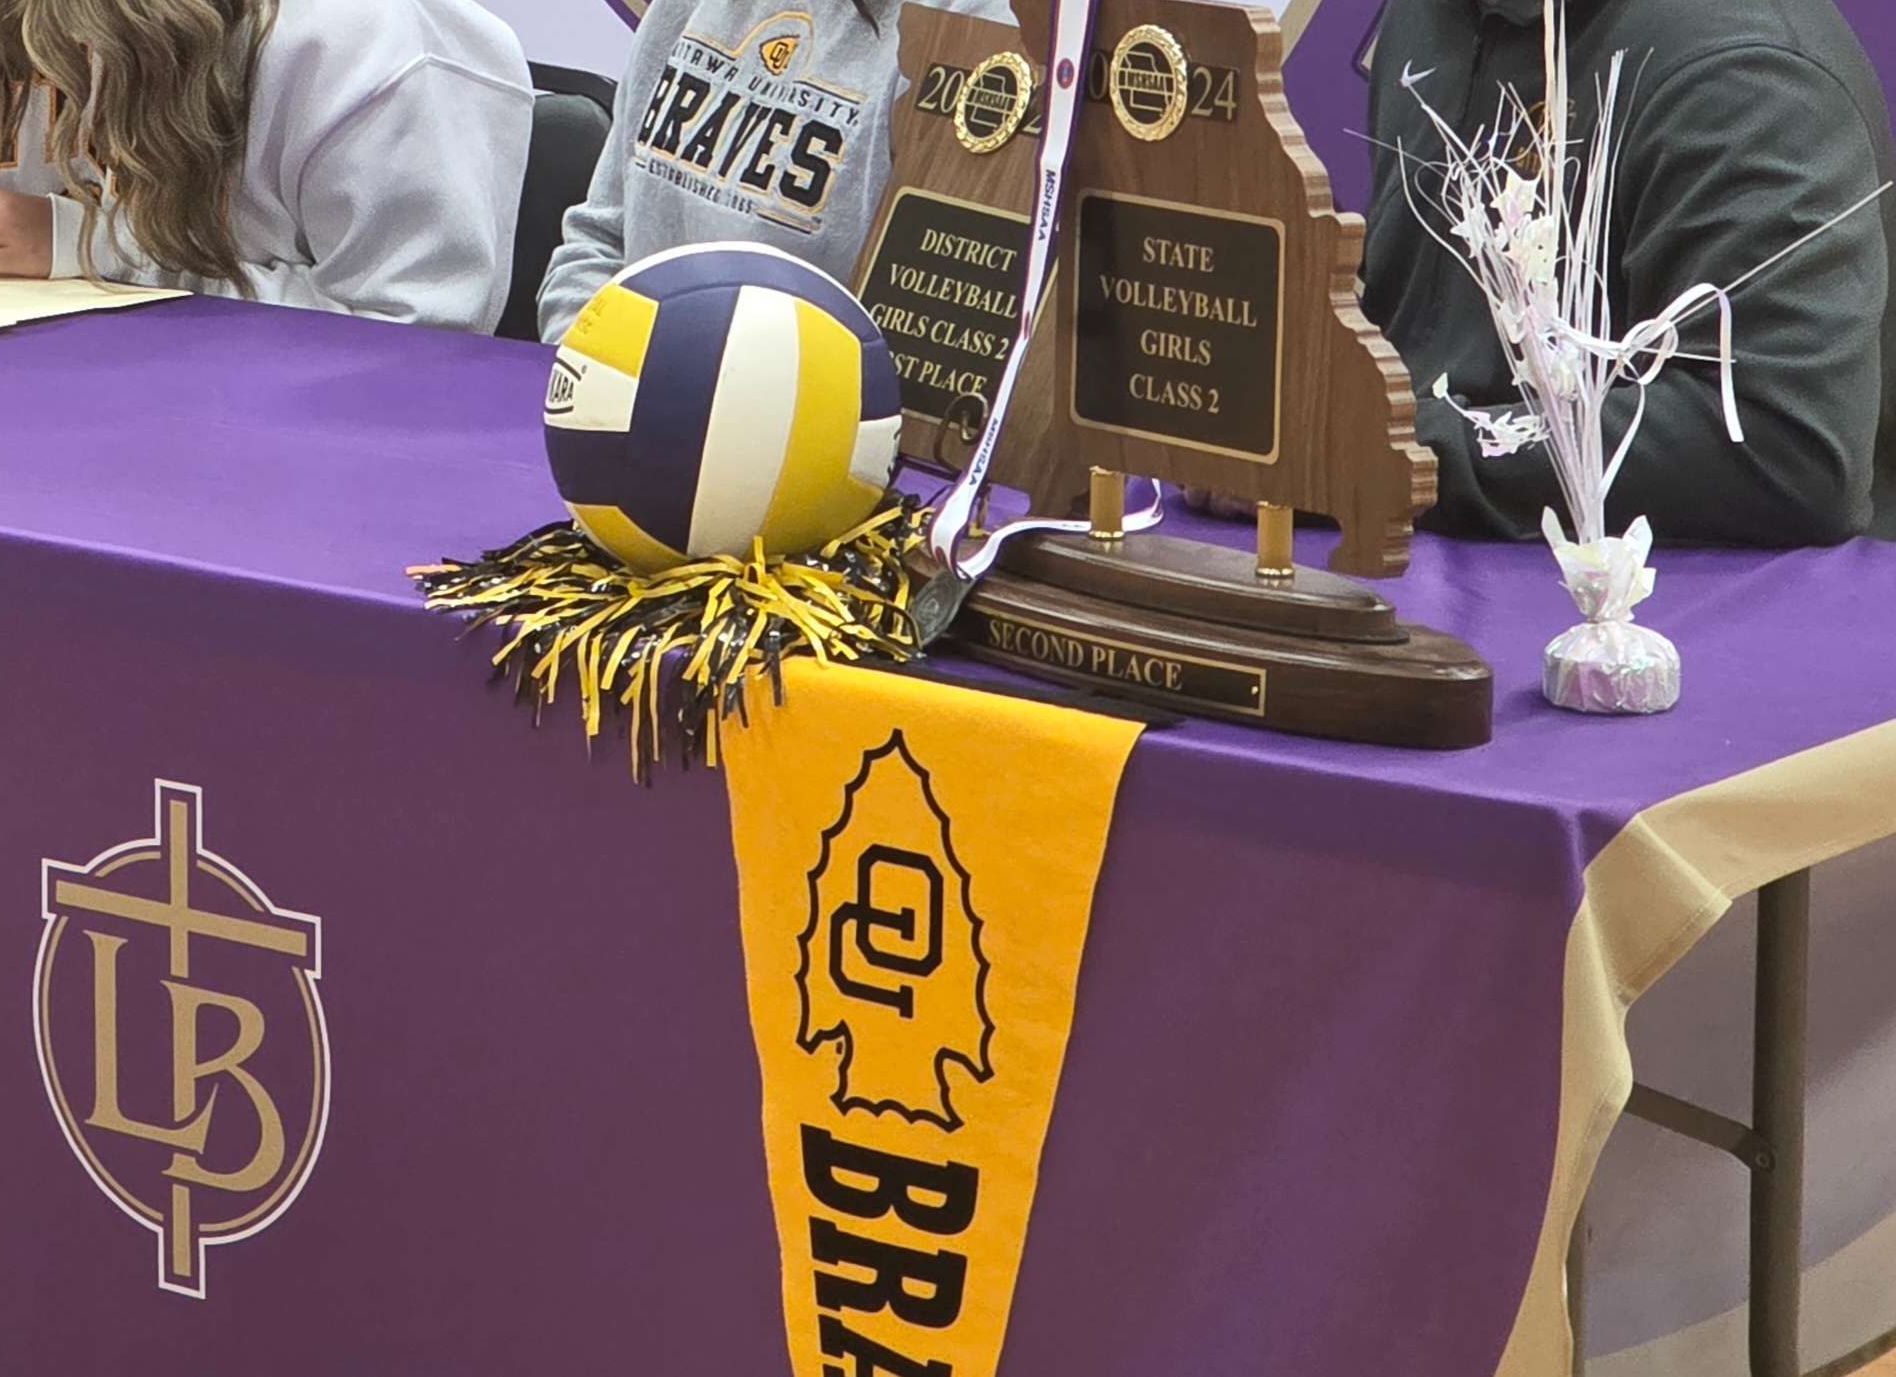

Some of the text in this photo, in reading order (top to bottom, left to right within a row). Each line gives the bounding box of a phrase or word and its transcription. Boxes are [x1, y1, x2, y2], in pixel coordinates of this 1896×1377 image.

[637, 63, 844, 209] BRAVES
[920, 229, 1017, 273] DISTRICT
[1142, 236, 1214, 273] STATE
[890, 263, 1017, 319] VOLLEYBALL
[1099, 274, 1257, 327] VOLLEYBALL
[870, 303, 1009, 361] GIRLS CLASS 2
[1140, 329, 1211, 366] GIRLS
[918, 361, 988, 395] PLACE
[1129, 373, 1219, 414] CLASS 2
[989, 619, 1184, 691] SECOND PLACE
[83, 929, 285, 1192] LB
